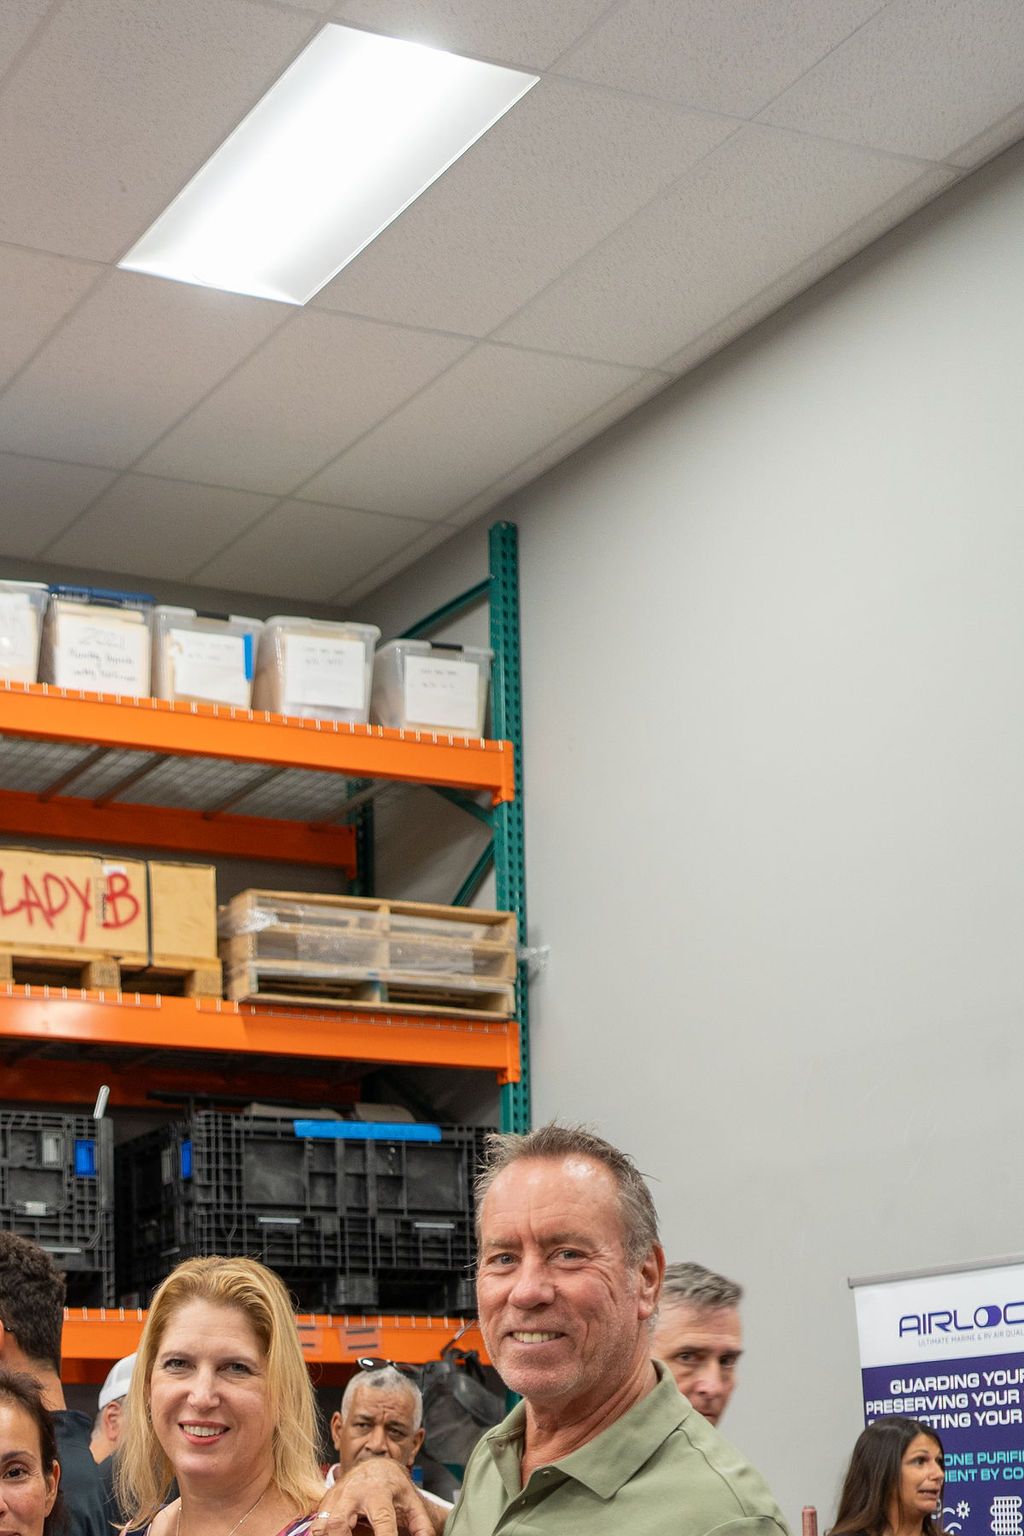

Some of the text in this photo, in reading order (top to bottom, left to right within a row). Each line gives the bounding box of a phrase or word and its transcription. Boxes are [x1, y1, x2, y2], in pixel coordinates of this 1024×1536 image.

[102, 872, 141, 930] B
[890, 1373, 980, 1395] GUARDING
[866, 1389, 1020, 1416] PRESERVING YOUR
[974, 1408, 1023, 1427] YOUR
[977, 1450, 1024, 1465] PURIFI
[981, 1467, 999, 1481] BY
